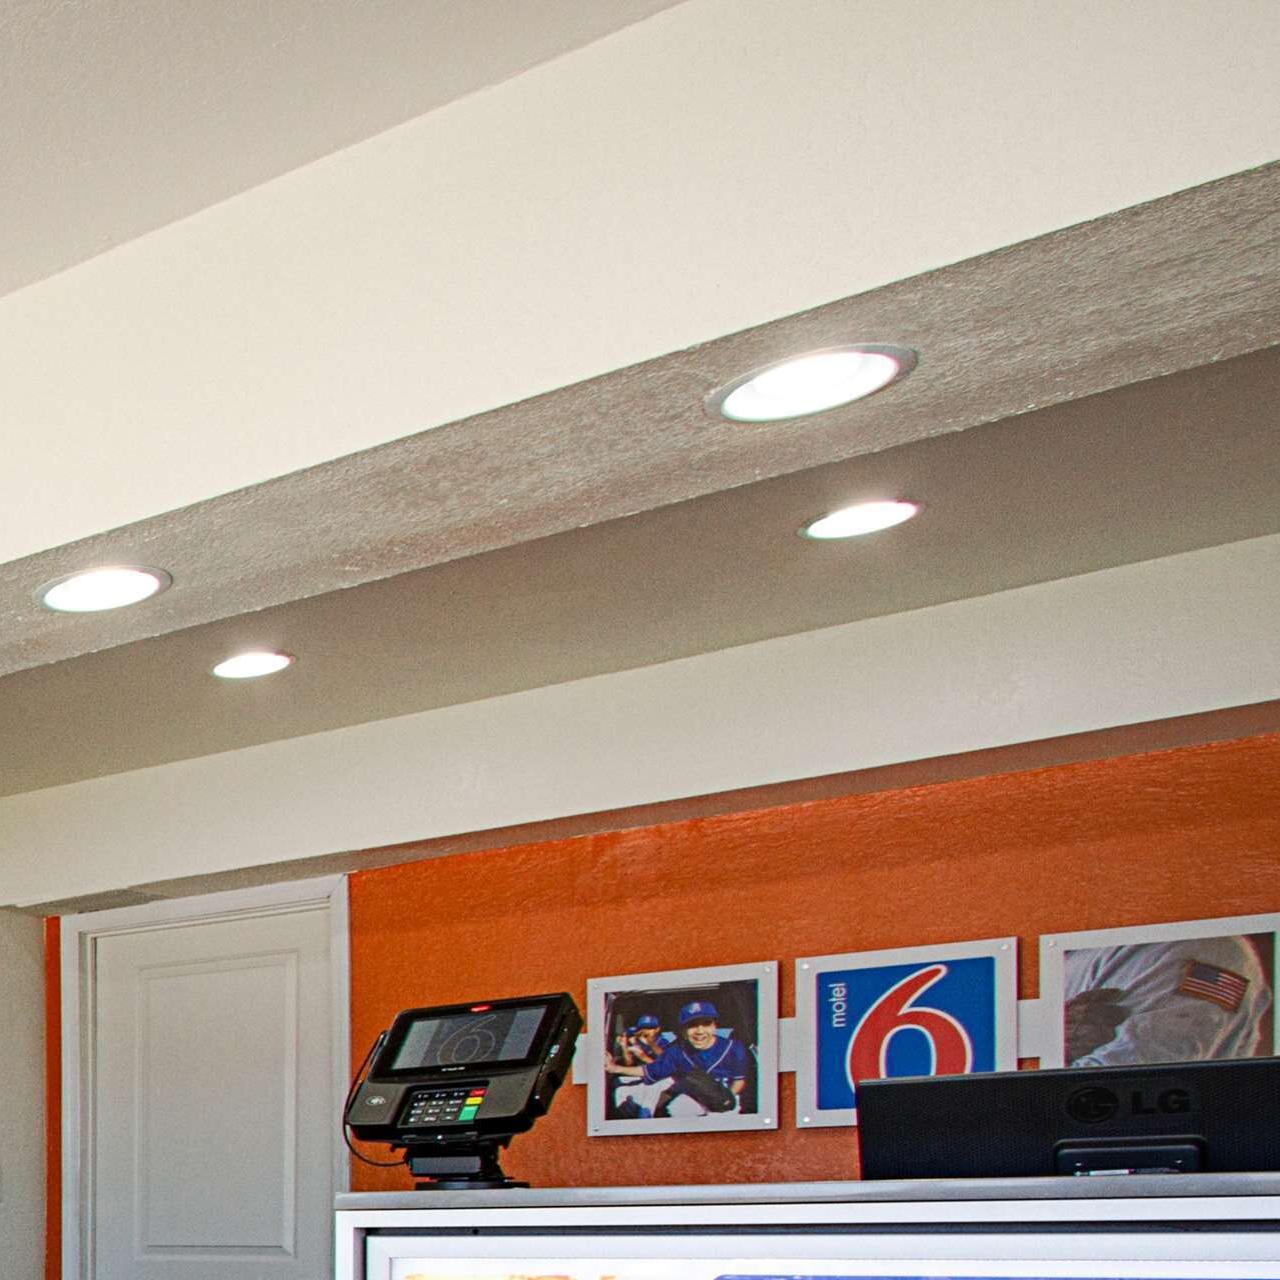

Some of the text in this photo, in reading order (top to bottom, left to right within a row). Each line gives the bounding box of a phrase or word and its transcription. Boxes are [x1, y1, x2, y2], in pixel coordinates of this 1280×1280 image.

[828, 982, 847, 1027] motel
[845, 964, 973, 1093] 6
[1132, 1088, 1191, 1115] LG
